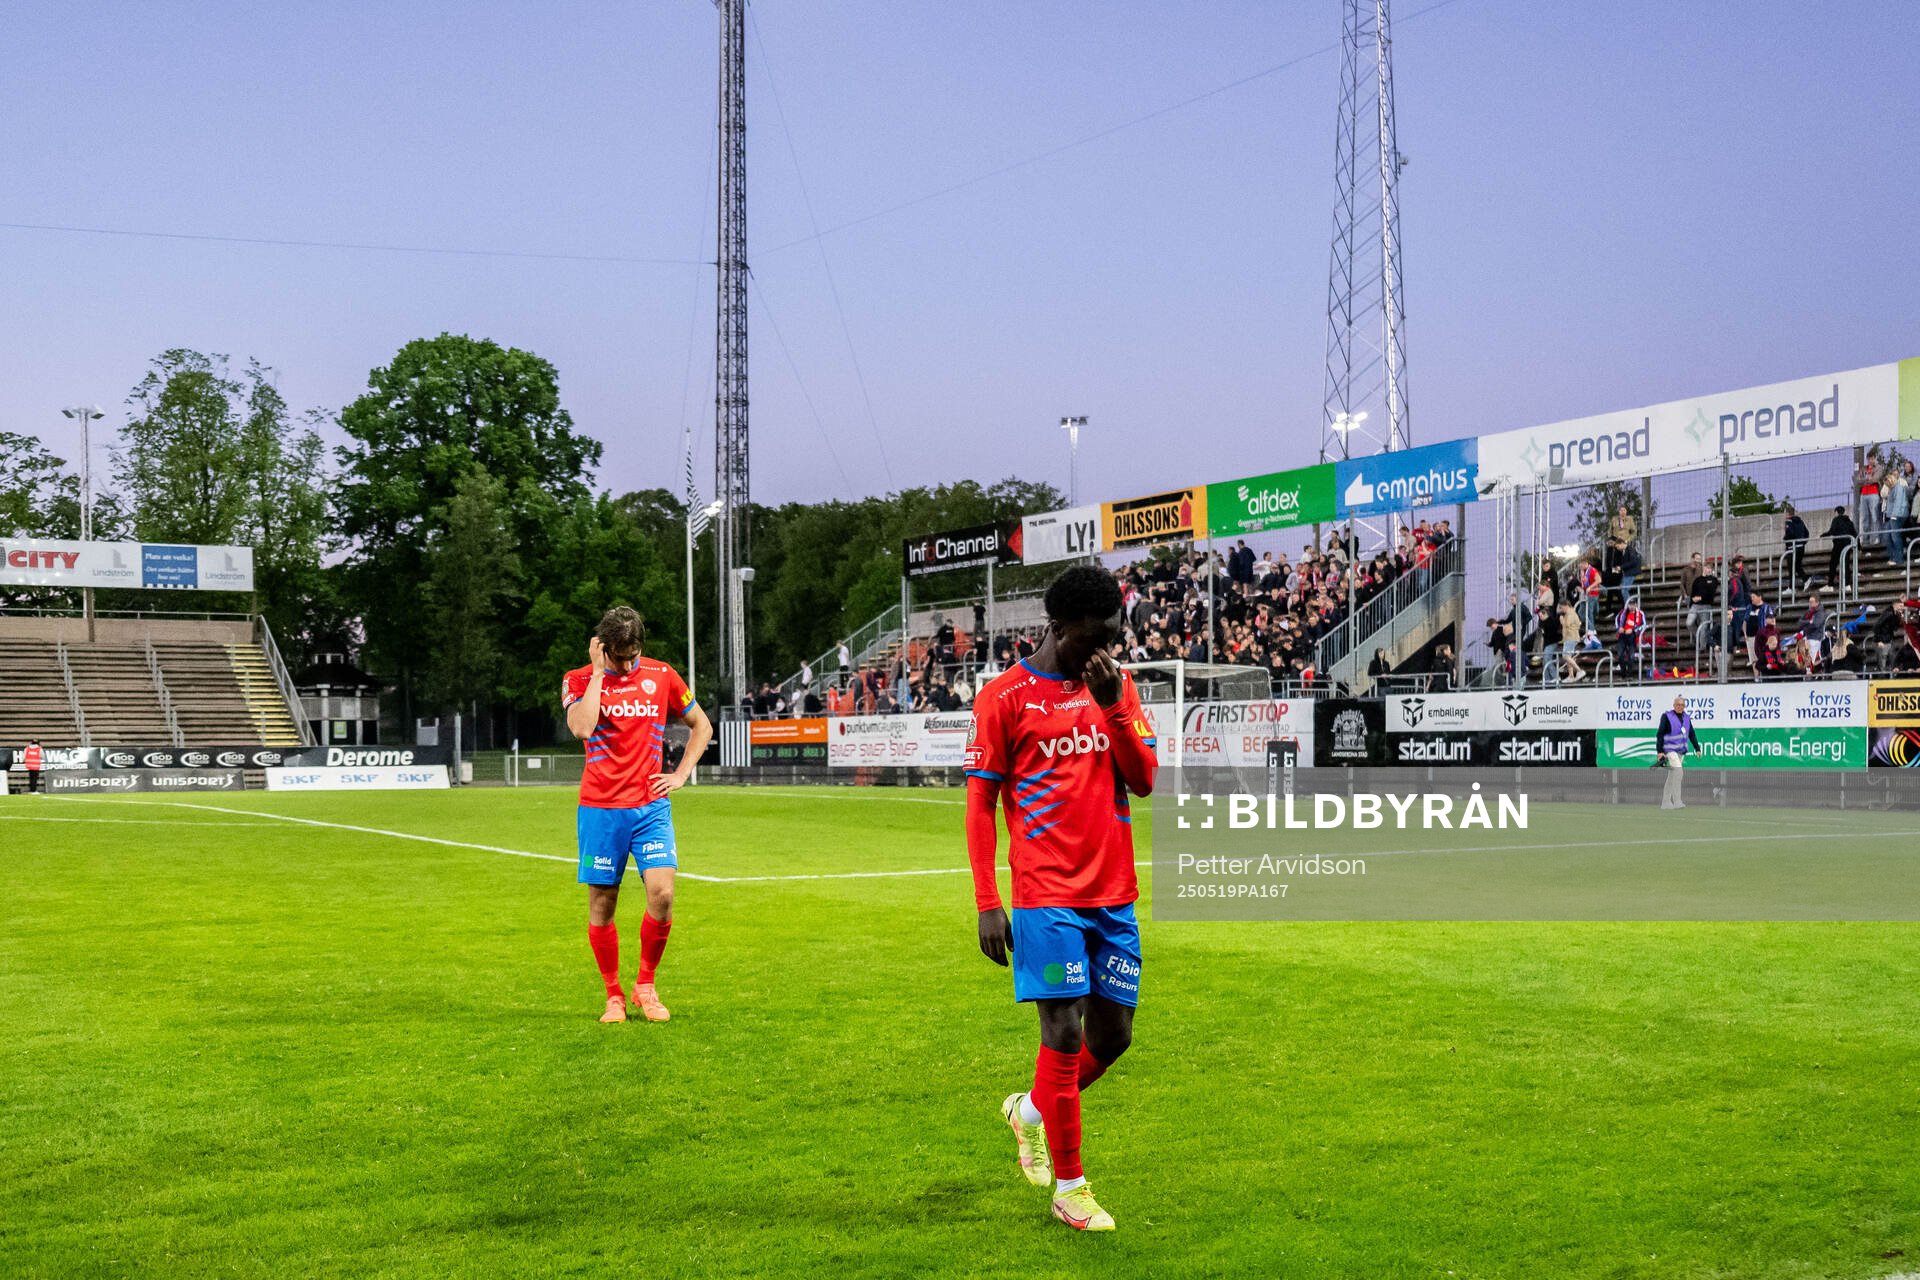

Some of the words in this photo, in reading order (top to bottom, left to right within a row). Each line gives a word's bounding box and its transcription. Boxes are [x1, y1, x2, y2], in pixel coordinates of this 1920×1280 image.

[1719, 384, 1839, 456] prenad
[1549, 417, 1649, 469] prenad
[1377, 468, 1468, 501] emrahus
[1247, 488, 1300, 515] alfdex
[1114, 505, 1180, 537] OHLSSONS
[908, 529, 998, 563] InfoChannel
[8, 550, 80, 569] CITY
[1616, 695, 1652, 709] forvis
[1678, 694, 1715, 708] orvis
[1741, 692, 1781, 707] forvis
[1810, 690, 1851, 705] forvis
[1878, 696, 1920, 711] OHLSS
[601, 699, 659, 717] vobbiz
[1606, 710, 1652, 721] mazars
[1690, 709, 1715, 720] zars
[1728, 708, 1781, 720] mazars
[1796, 706, 1851, 719] mazars
[1038, 725, 1111, 758] vobb
[1167, 737, 1221, 752] BFESA
[1398, 737, 1471, 761] stadium
[1499, 736, 1581, 761] stadium
[1790, 736, 1847, 760] Energi
[327, 748, 414, 766] Derome
[282, 775, 321, 785] SKF
[341, 774, 379, 784] SKF
[397, 773, 436, 783] SKF
[642, 840, 665, 853] Fibio
[1107, 955, 1140, 977] Fibio
